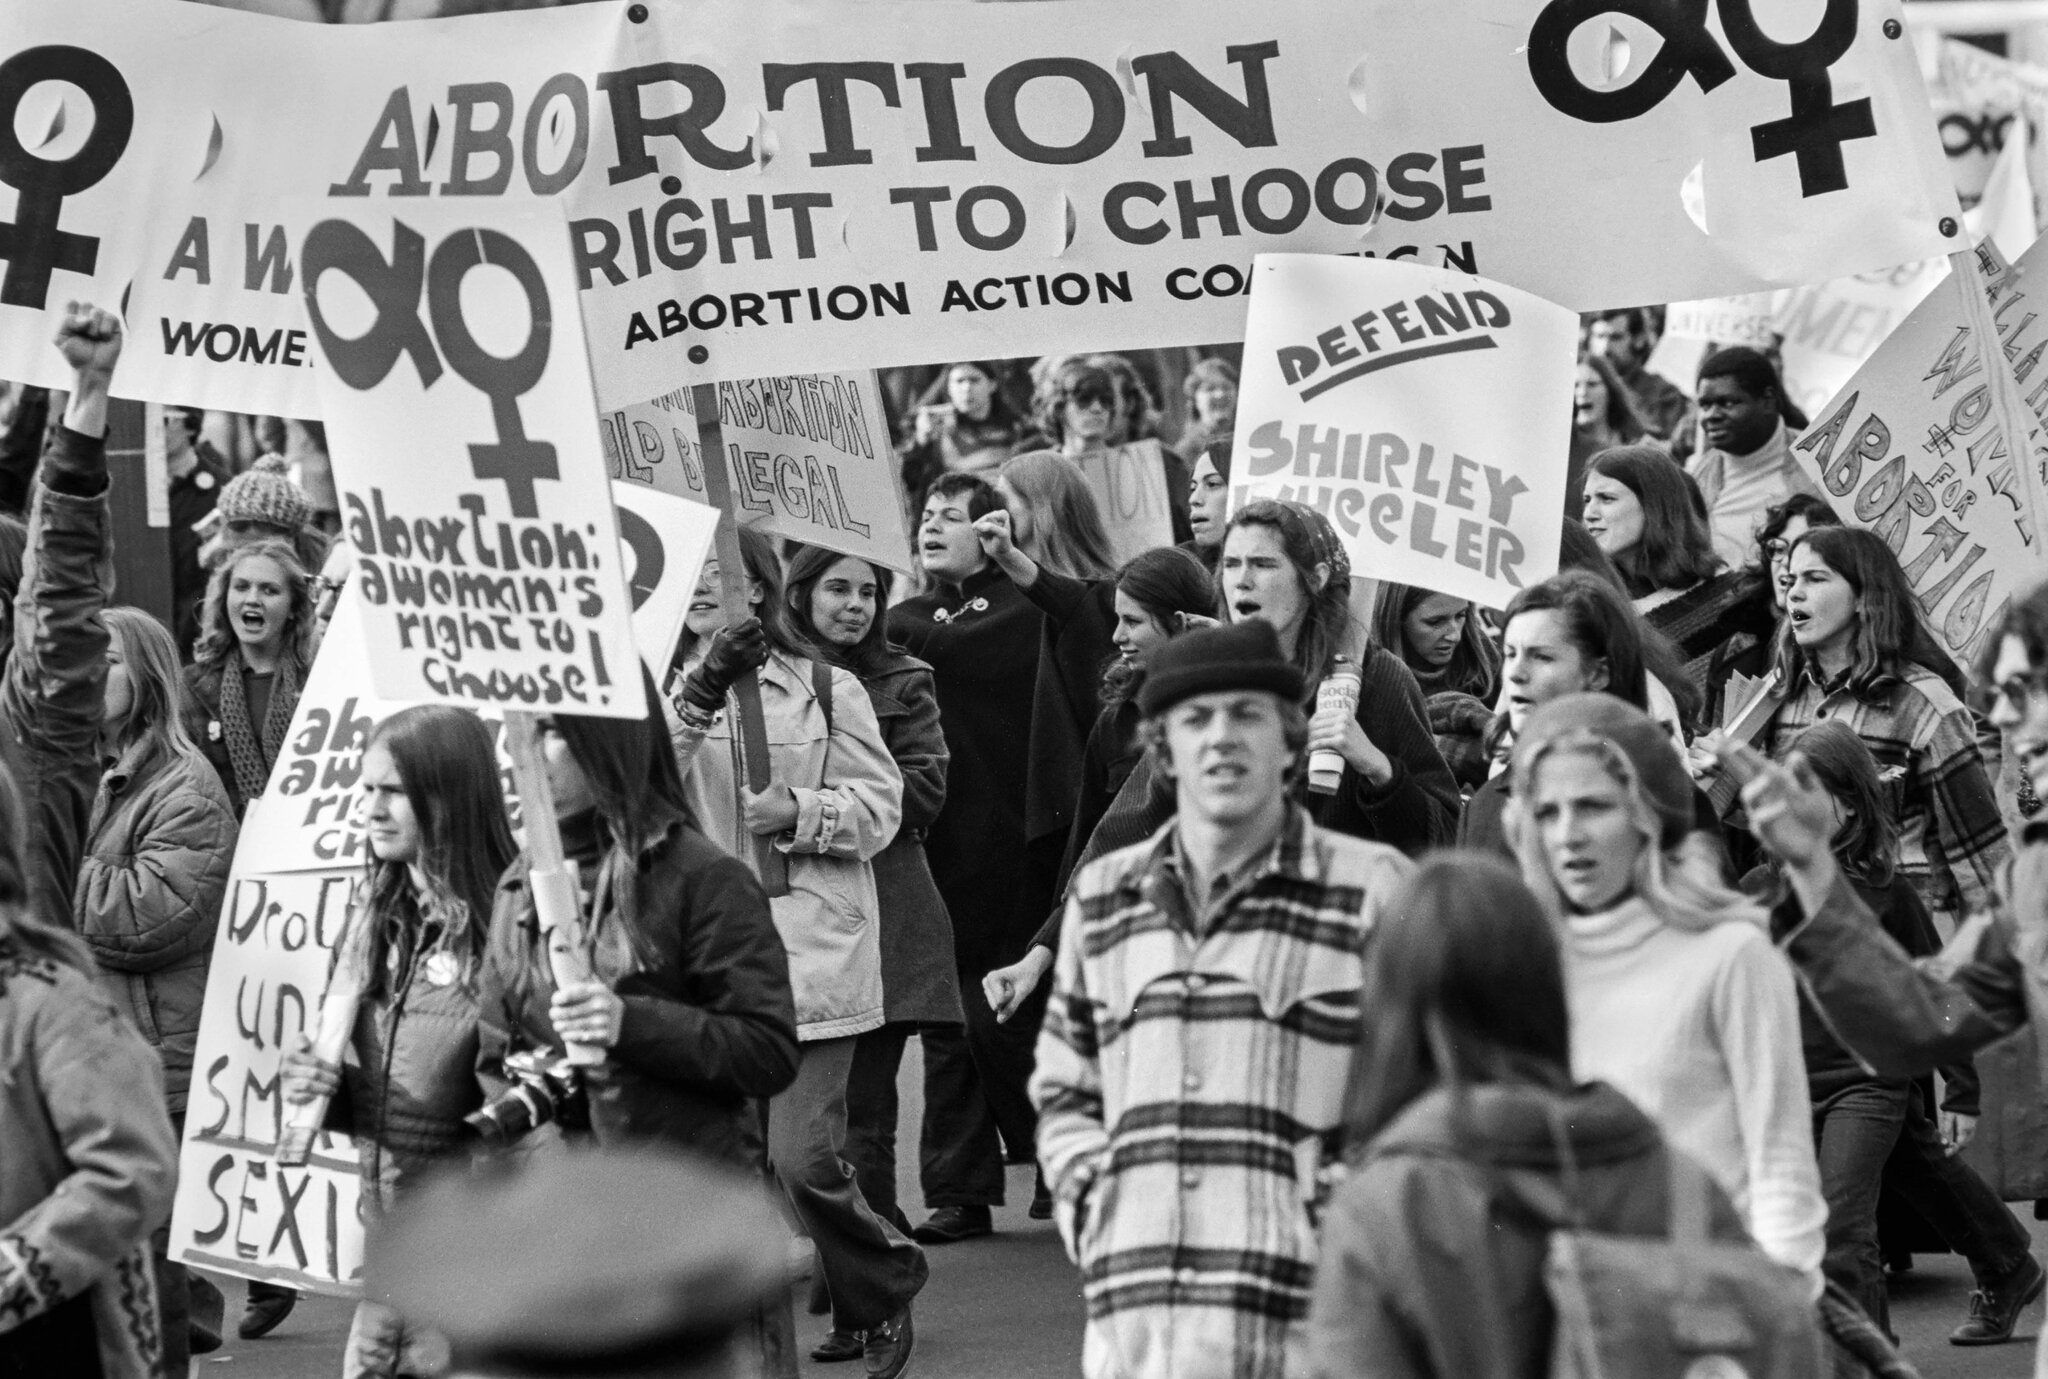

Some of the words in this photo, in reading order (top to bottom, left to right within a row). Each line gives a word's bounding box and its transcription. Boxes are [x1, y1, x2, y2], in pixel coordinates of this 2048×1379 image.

[328, 39, 1280, 196] ABORTION
[163, 216, 211, 285] A
[568, 191, 833, 291] RIGHT
[889, 184, 1026, 253] TO
[1102, 143, 1492, 246] CHOOSE
[160, 316, 313, 368] WOME
[624, 281, 911, 350] ABORTION
[940, 270, 1132, 313] ACTION
[1276, 290, 1511, 386] DEFEND
[729, 443, 871, 540] LEGAL
[1248, 420, 1530, 527] SHIRLEY
[1925, 462, 1978, 521] FOR
[345, 486, 600, 571] abortion:
[396, 611, 521, 662] right
[528, 616, 576, 653] to
[194, 1153, 363, 1283] SEXI
